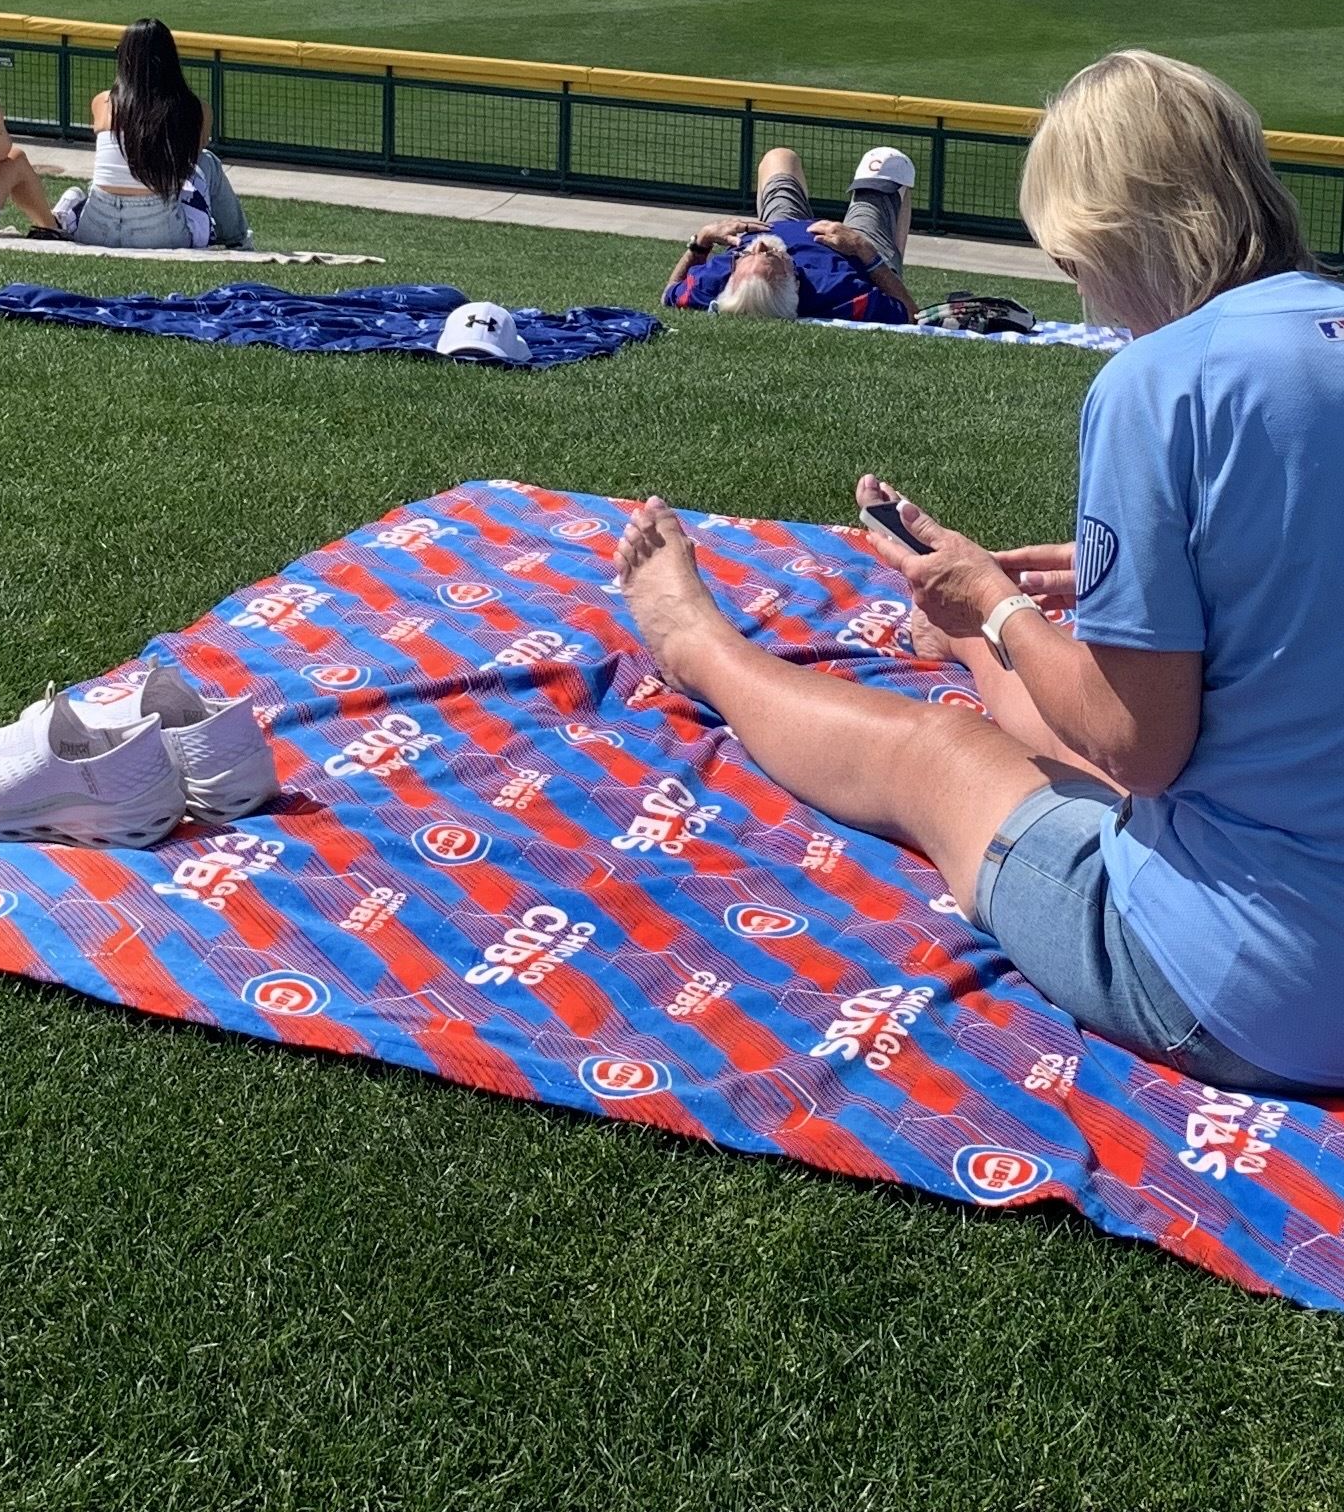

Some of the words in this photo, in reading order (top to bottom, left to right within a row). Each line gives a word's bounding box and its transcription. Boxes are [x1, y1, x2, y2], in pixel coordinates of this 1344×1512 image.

[869, 159, 882, 171] C
[324, 714, 422, 778] CUBS
[368, 734, 443, 778] CHICAGO
[492, 769, 541, 809] CUBS
[611, 778, 696, 852] CUBS
[339, 887, 393, 932] CUBS
[365, 892, 406, 934] CHICAGO
[465, 905, 569, 986] CUBS
[518, 922, 597, 986] CHICAGO
[667, 971, 718, 1017] CUBS
[809, 984, 903, 1062] CUBS
[865, 986, 935, 1071] CHICAGO
